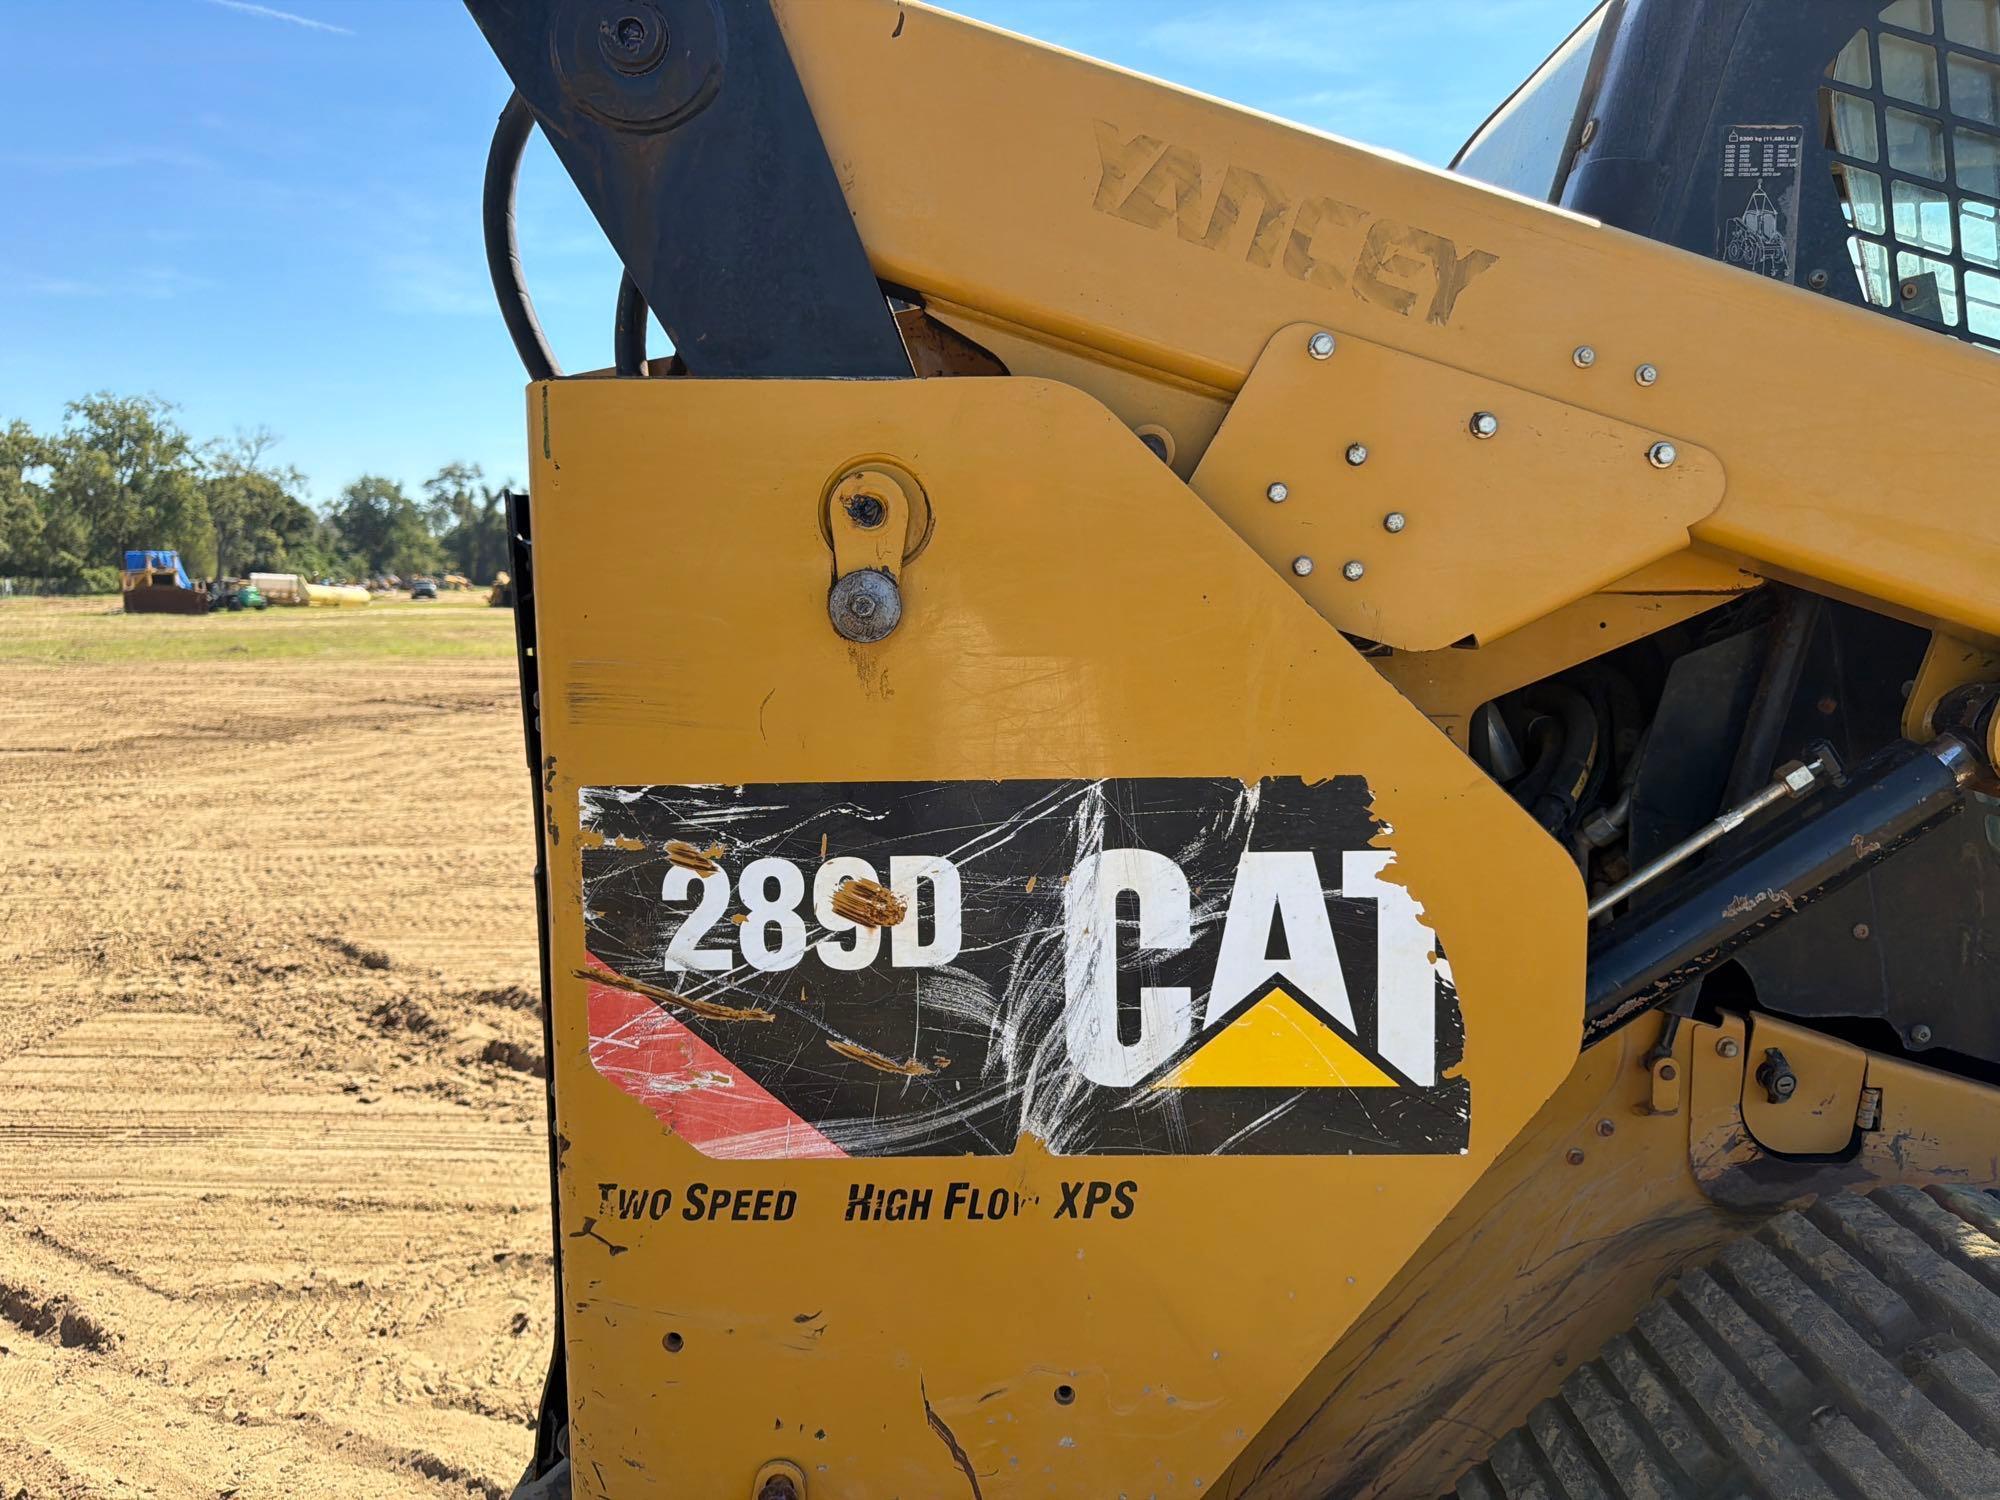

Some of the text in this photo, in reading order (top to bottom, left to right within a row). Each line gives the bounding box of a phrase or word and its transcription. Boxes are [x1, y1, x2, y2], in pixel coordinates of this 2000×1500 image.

[661, 855, 962, 972] 289D
[1064, 848, 1435, 1088] CAT
[682, 1182, 798, 1221] SPEED
[845, 1183, 933, 1221] HIGH
[1053, 1180, 1138, 1220] XPS
